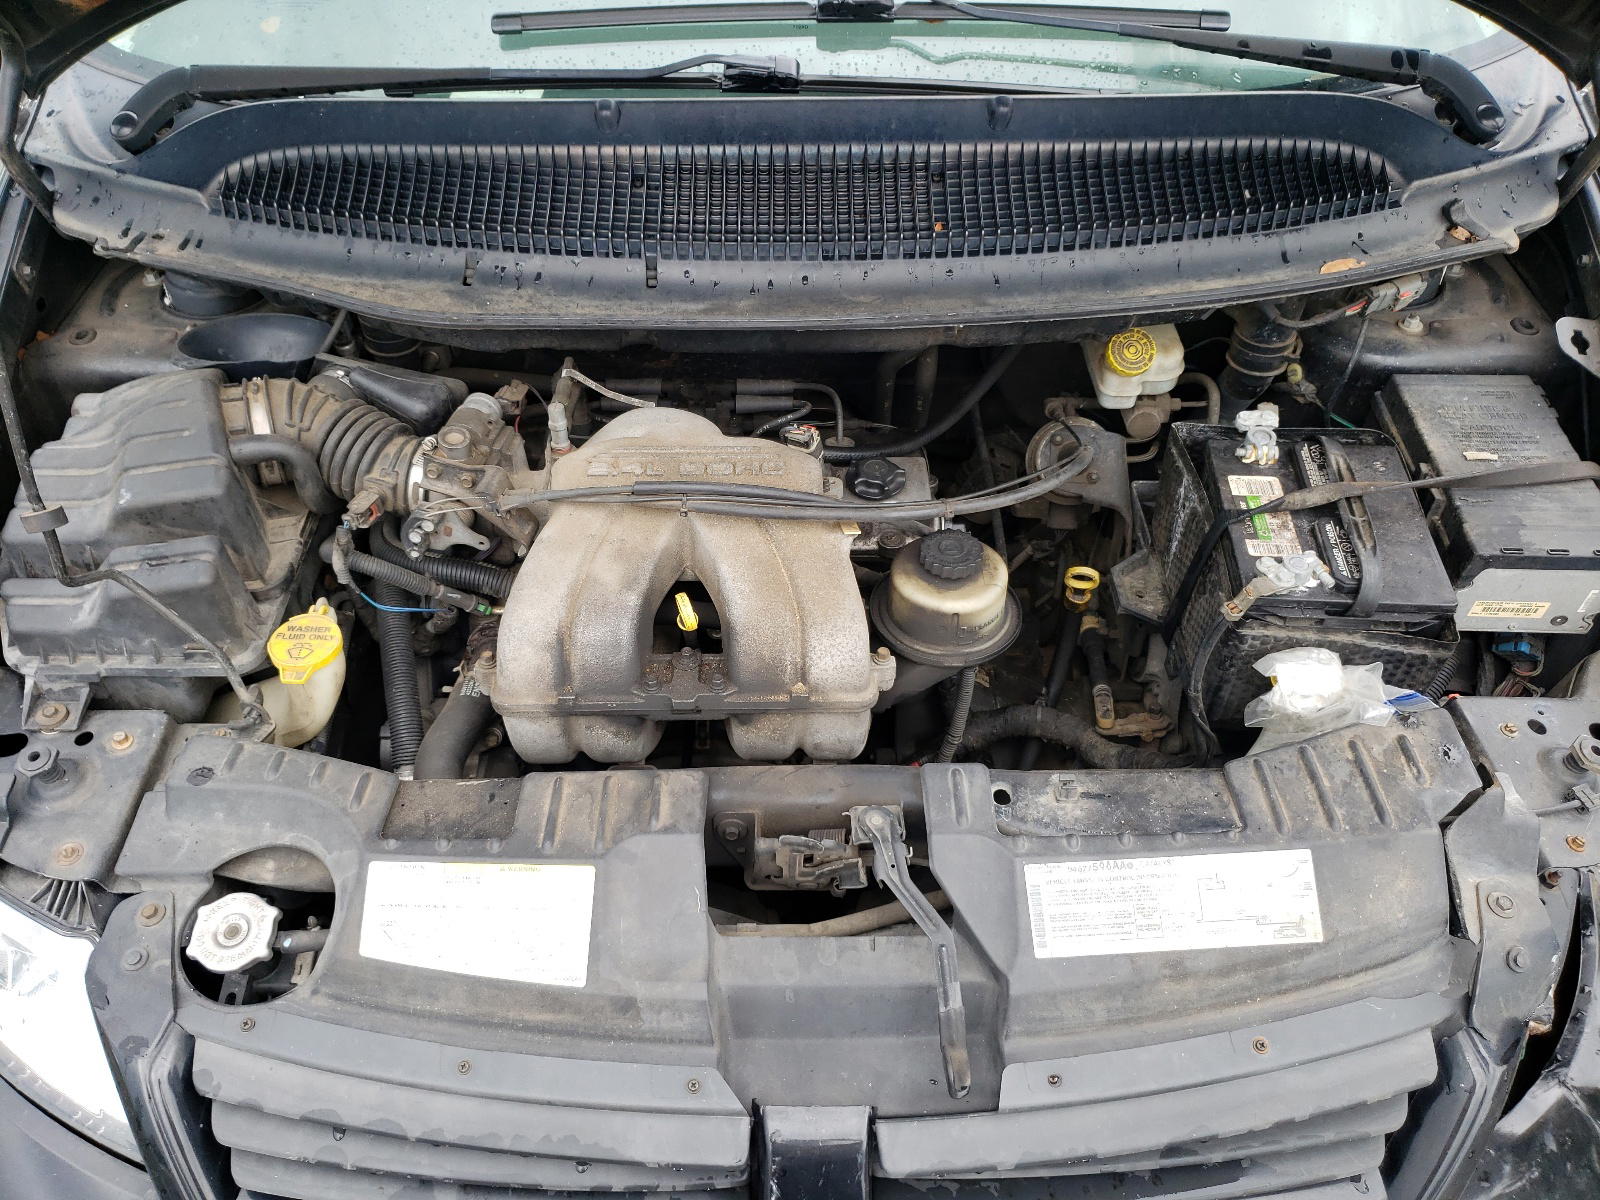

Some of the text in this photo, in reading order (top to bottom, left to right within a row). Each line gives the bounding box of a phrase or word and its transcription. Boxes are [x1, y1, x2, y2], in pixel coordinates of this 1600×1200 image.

[287, 625, 331, 633] WASHER
[275, 632, 337, 641] FLUID ONLY
